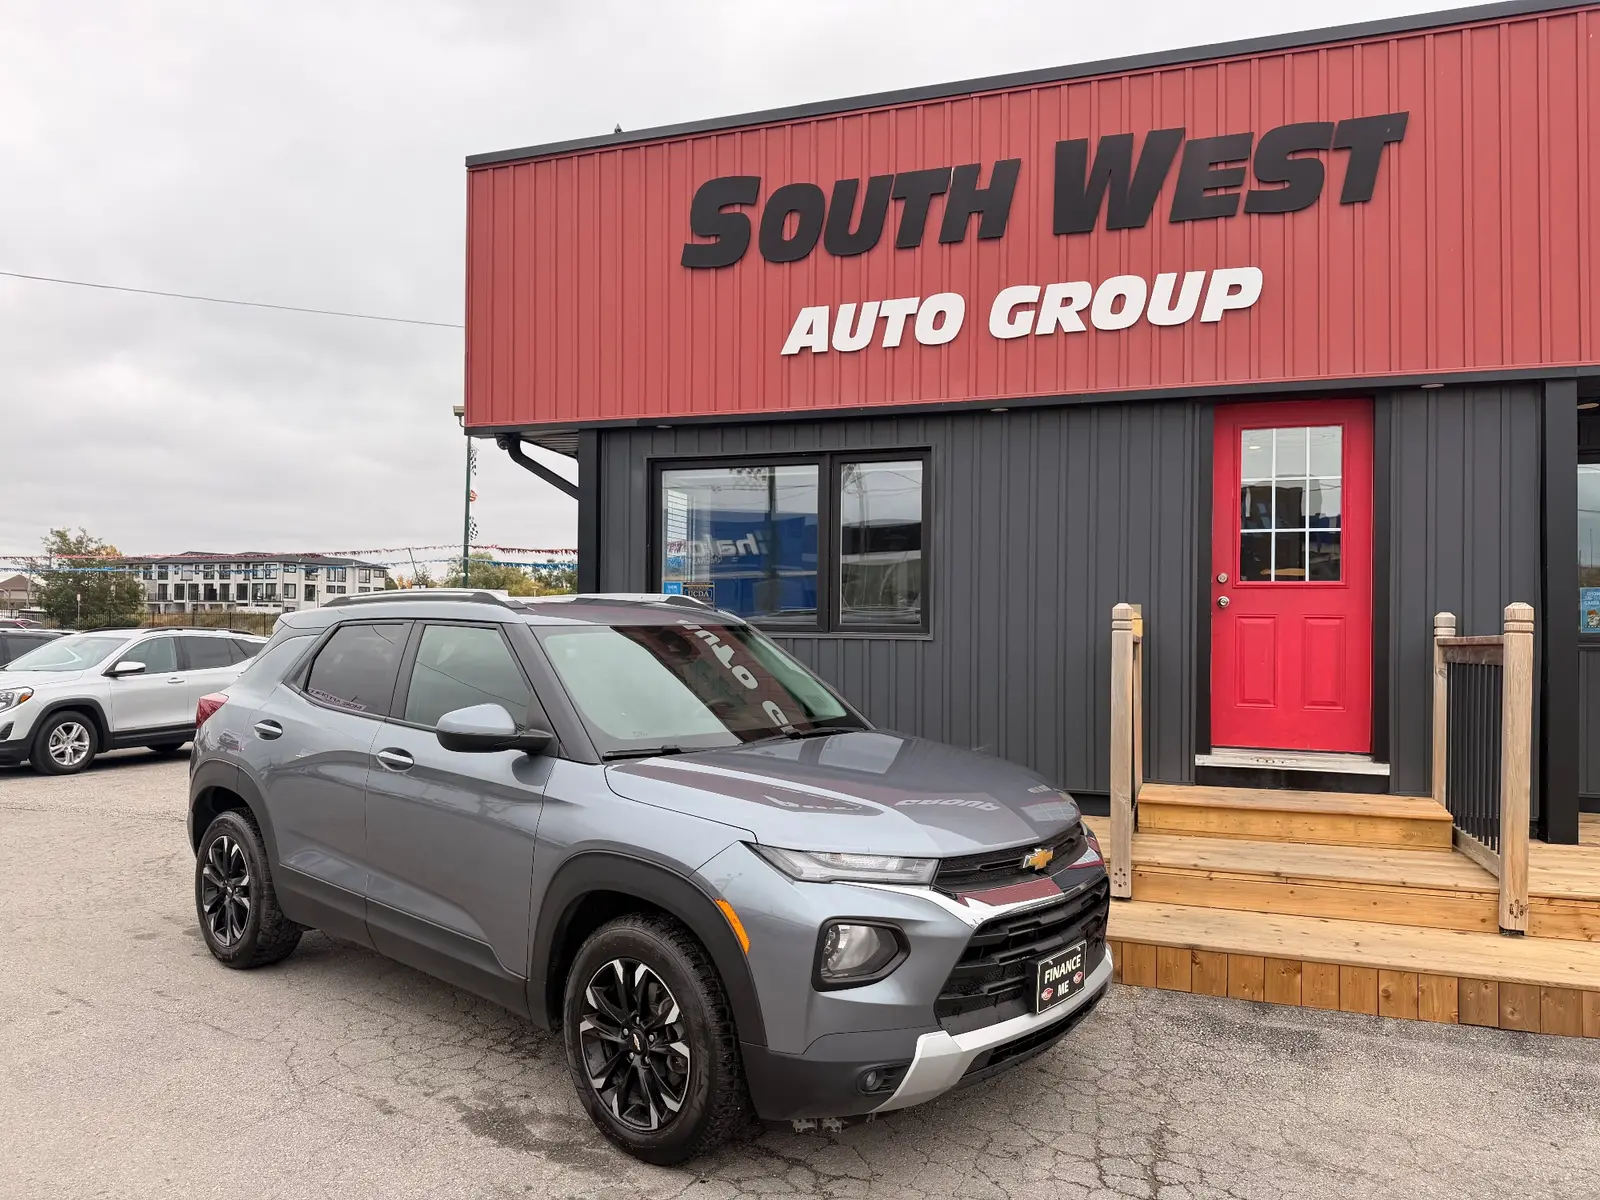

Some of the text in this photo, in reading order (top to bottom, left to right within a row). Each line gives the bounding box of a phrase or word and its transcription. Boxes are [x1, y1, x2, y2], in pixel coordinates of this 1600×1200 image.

[681, 111, 1409, 269] SOUTH WEST
[780, 267, 1263, 355] AUTO GROUP
[1044, 954, 1081, 984] FINANCE
[1057, 980, 1070, 997] ME
